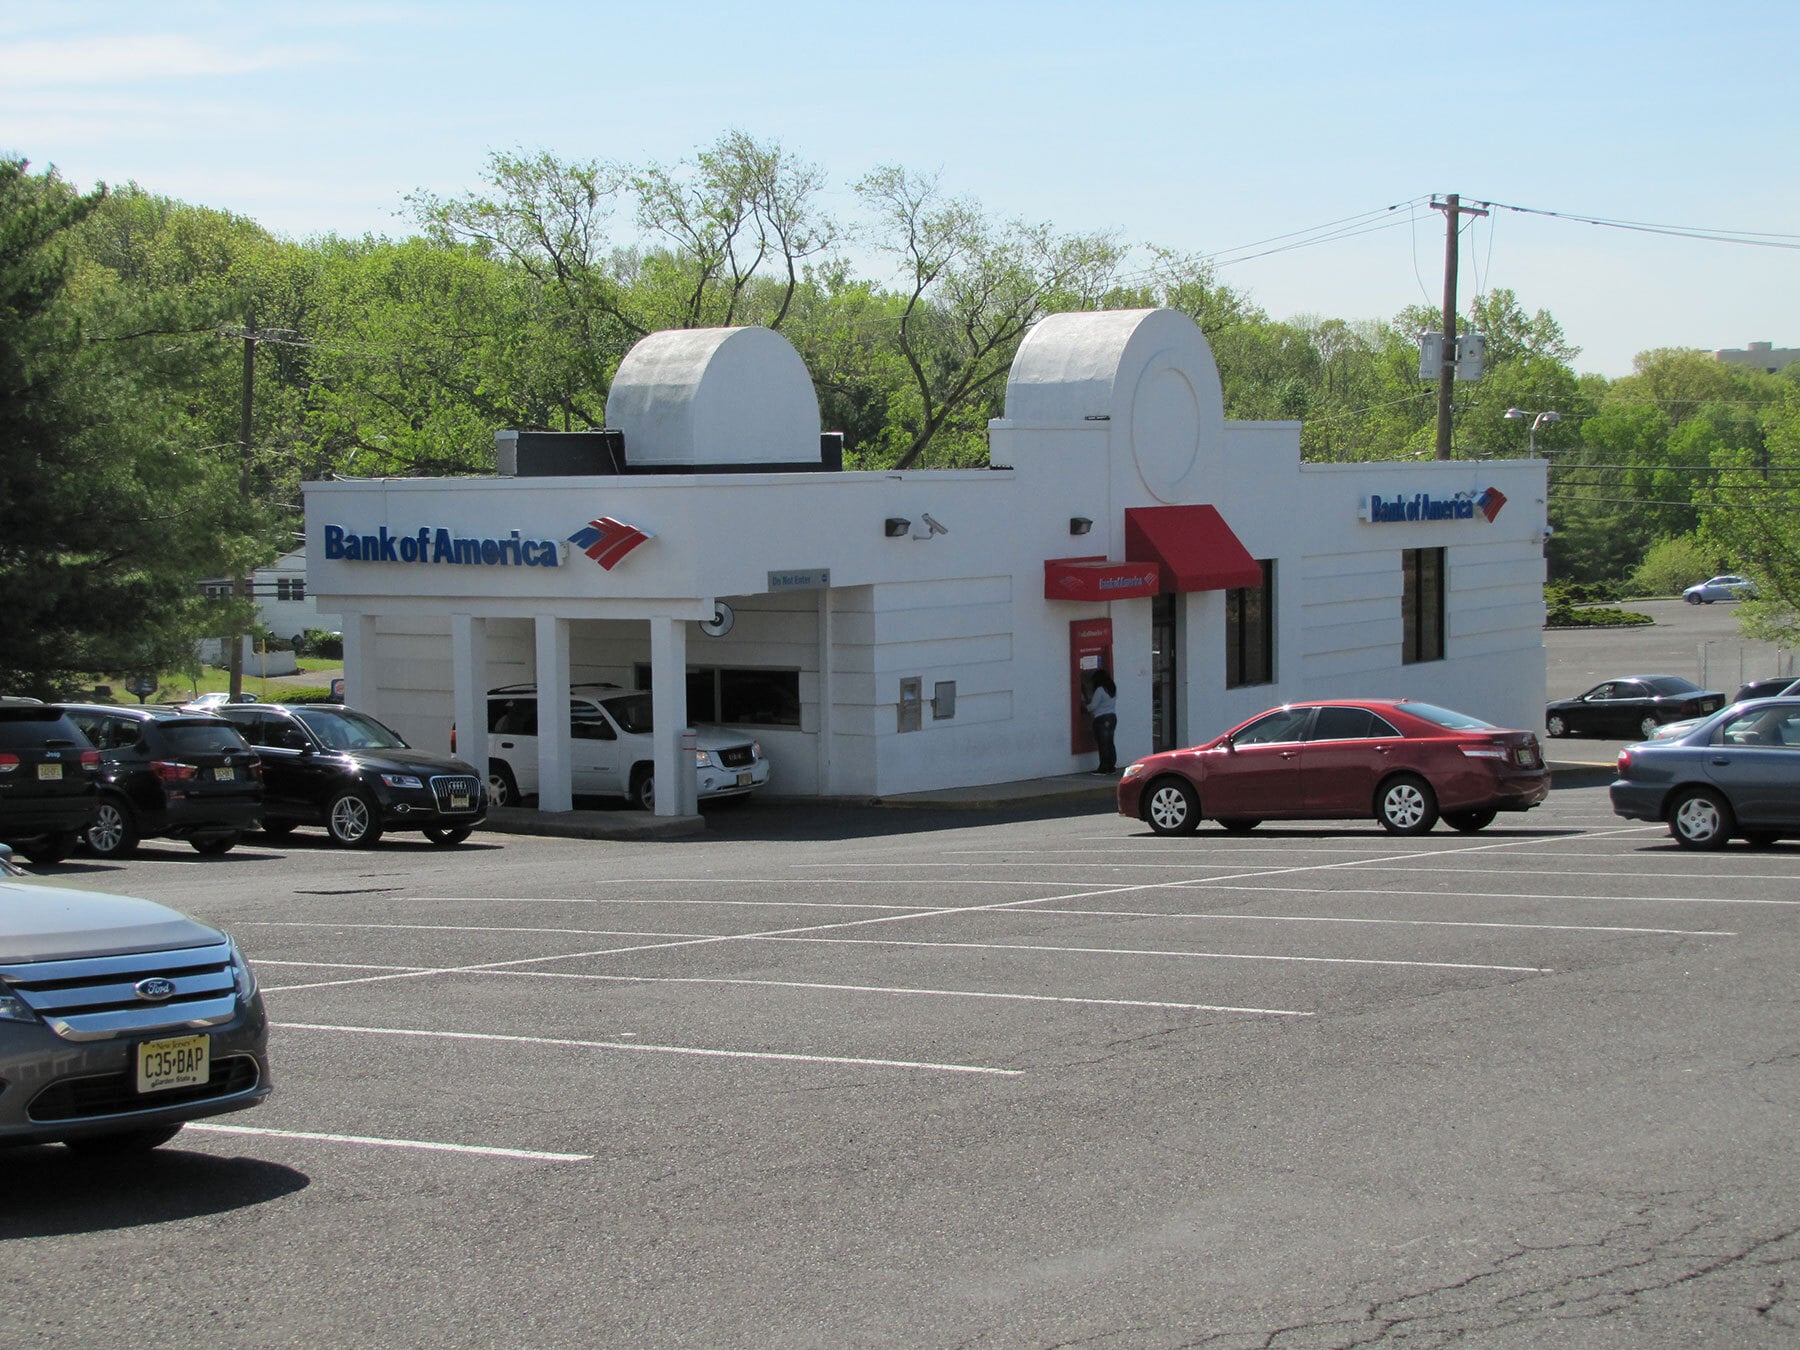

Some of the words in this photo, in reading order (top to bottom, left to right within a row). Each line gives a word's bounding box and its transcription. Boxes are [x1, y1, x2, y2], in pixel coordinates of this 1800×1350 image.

[1371, 494, 1406, 522] Bank
[1406, 493, 1421, 521] of
[1421, 493, 1473, 520] America
[325, 524, 398, 562] Bank
[400, 527, 432, 563] of
[433, 527, 559, 567] America
[147, 981, 170, 994] Ford
[156, 1042, 173, 1051] New
